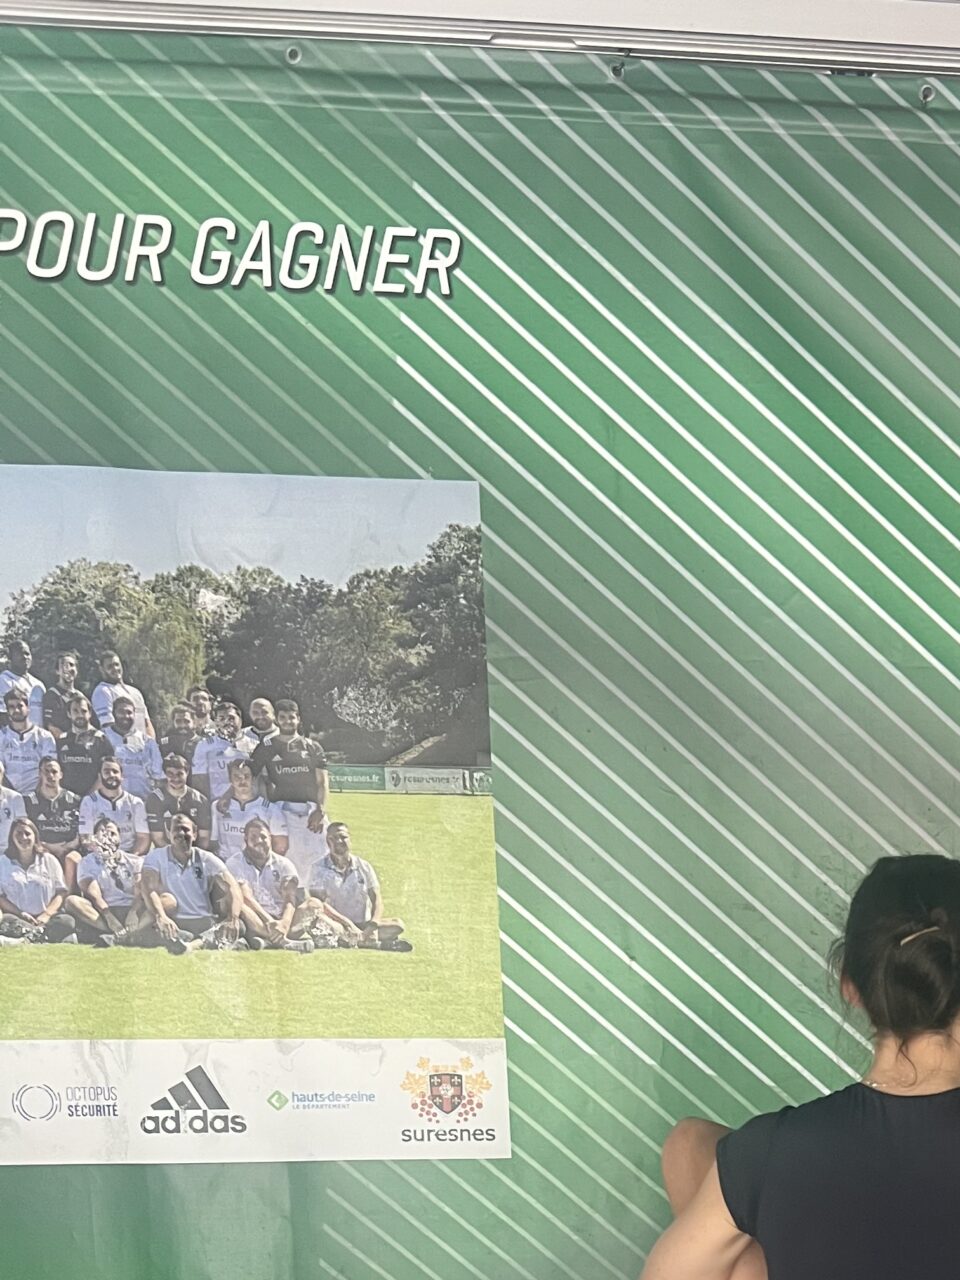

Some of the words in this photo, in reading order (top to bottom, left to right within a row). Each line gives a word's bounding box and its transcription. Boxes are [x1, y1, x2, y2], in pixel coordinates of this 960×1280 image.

[190, 217, 461, 295] GAGNER
[66, 1086, 118, 1101] OCTOPUS
[292, 1091, 376, 1103] hauts-de-seine
[67, 1102, 119, 1117] SÉCURITÉ
[401, 1127, 496, 1142] suresnes
